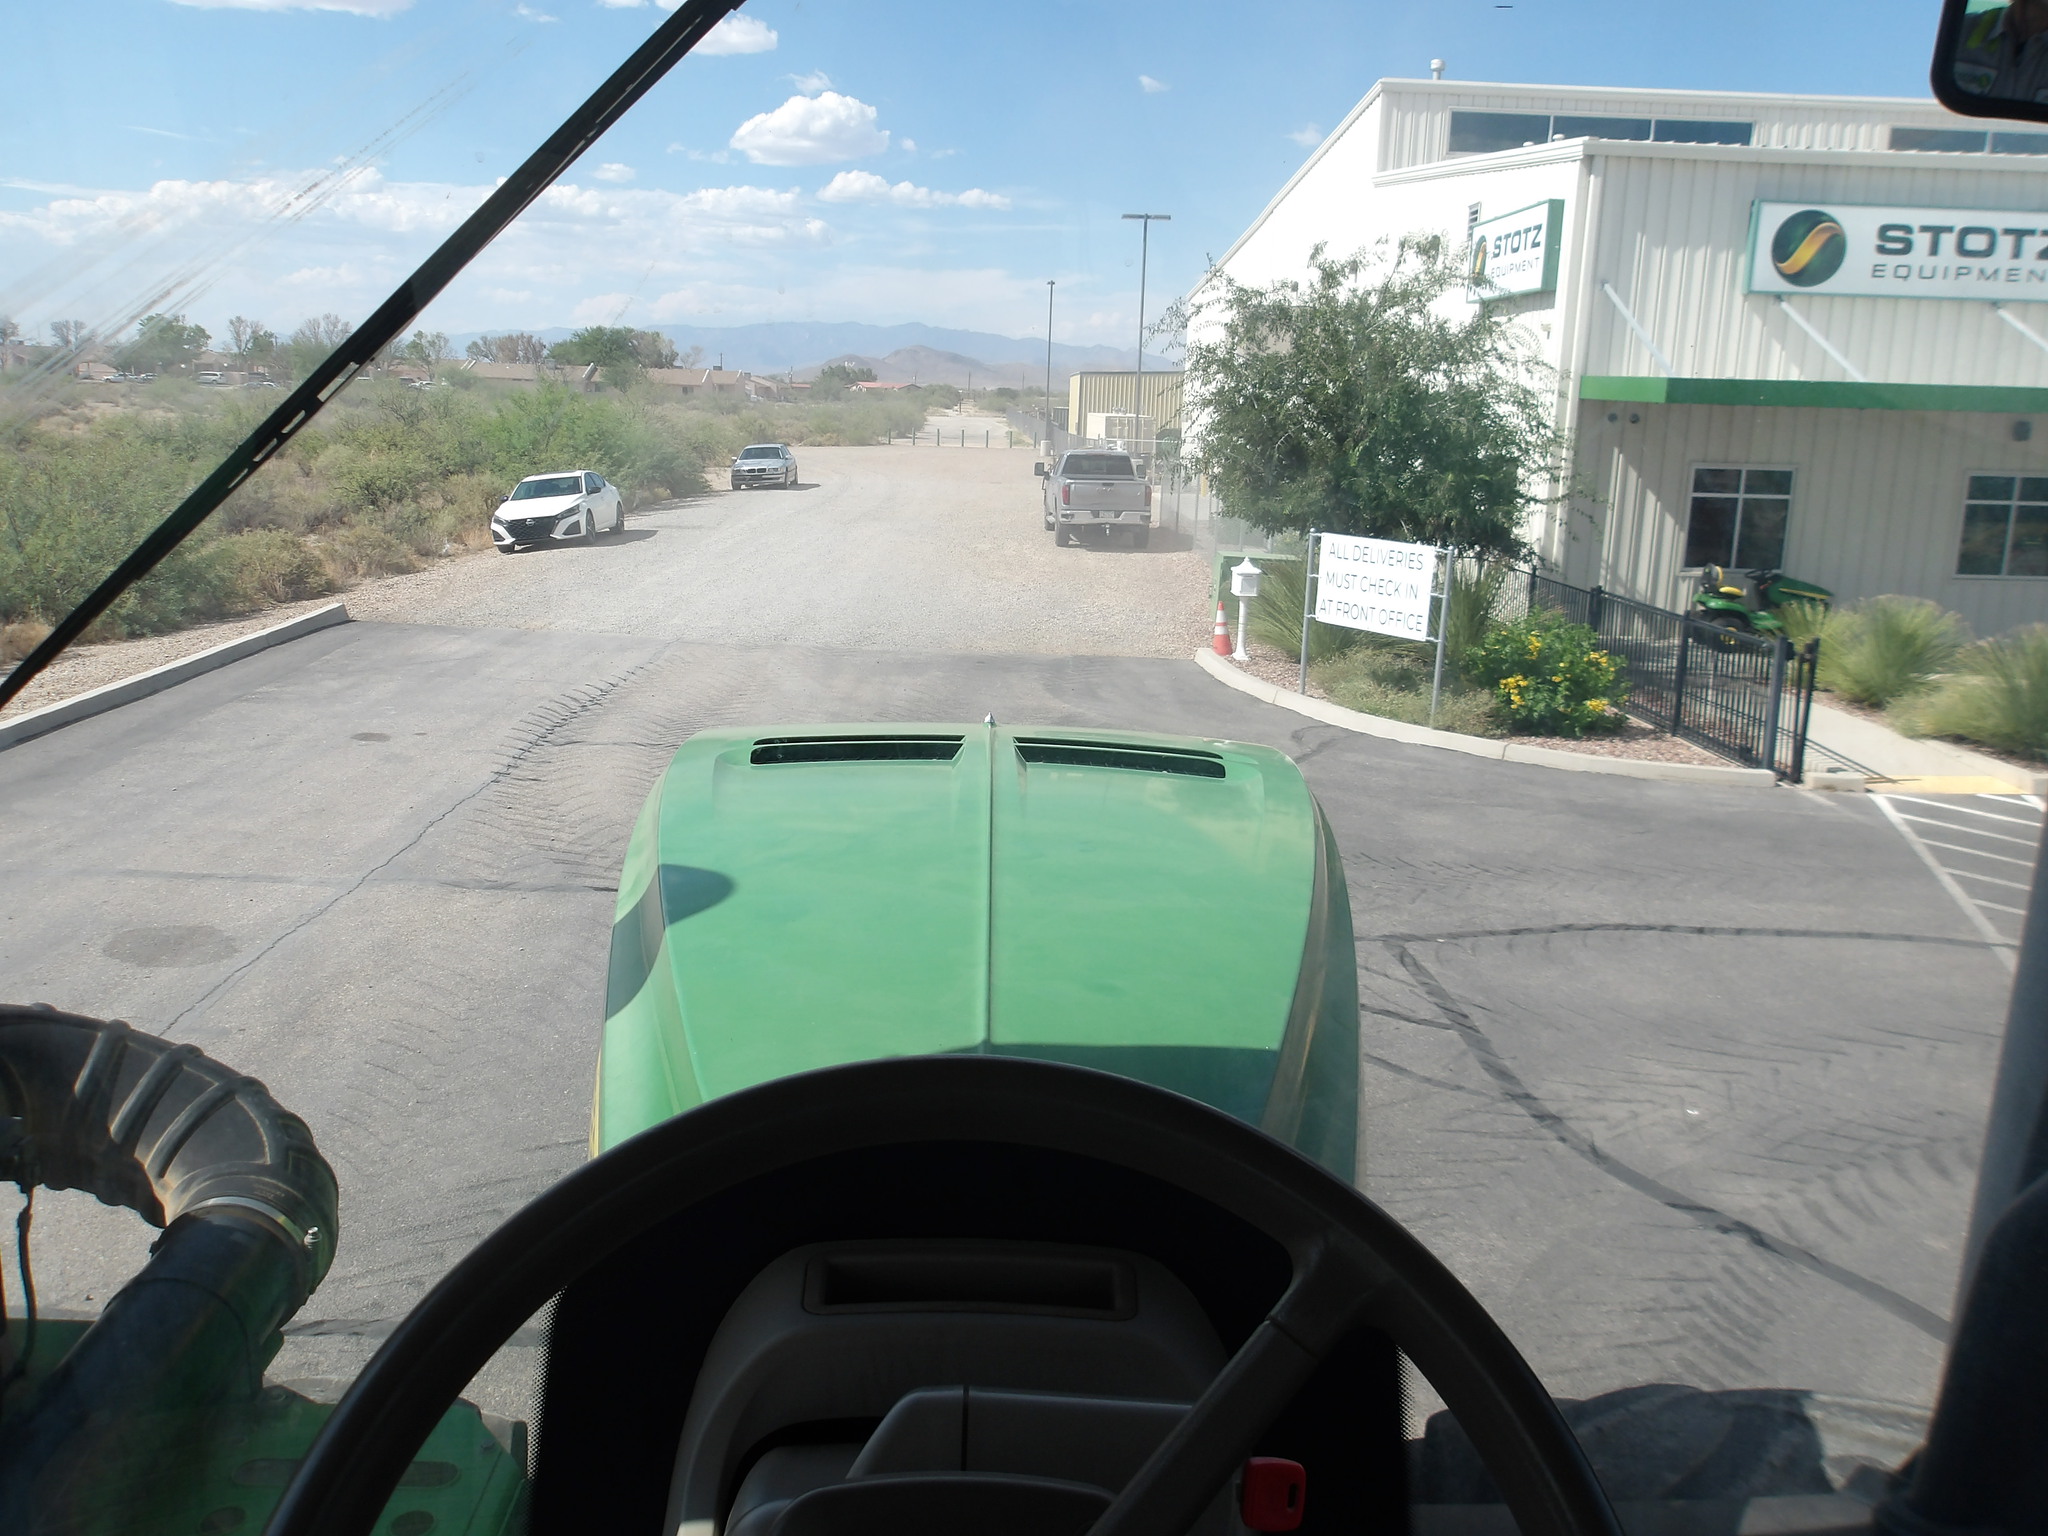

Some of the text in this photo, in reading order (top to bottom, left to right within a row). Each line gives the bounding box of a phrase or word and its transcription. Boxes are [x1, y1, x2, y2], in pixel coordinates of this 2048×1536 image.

[1492, 224, 1543, 259] STOTZ
[1490, 257, 1540, 279] EQUIPMENT
[1328, 542, 1424, 571] ALL DELIVERIES
[1325, 570, 1418, 600] MUST CHECK IN
[1318, 598, 1424, 632] AT FRONT OFFICE
